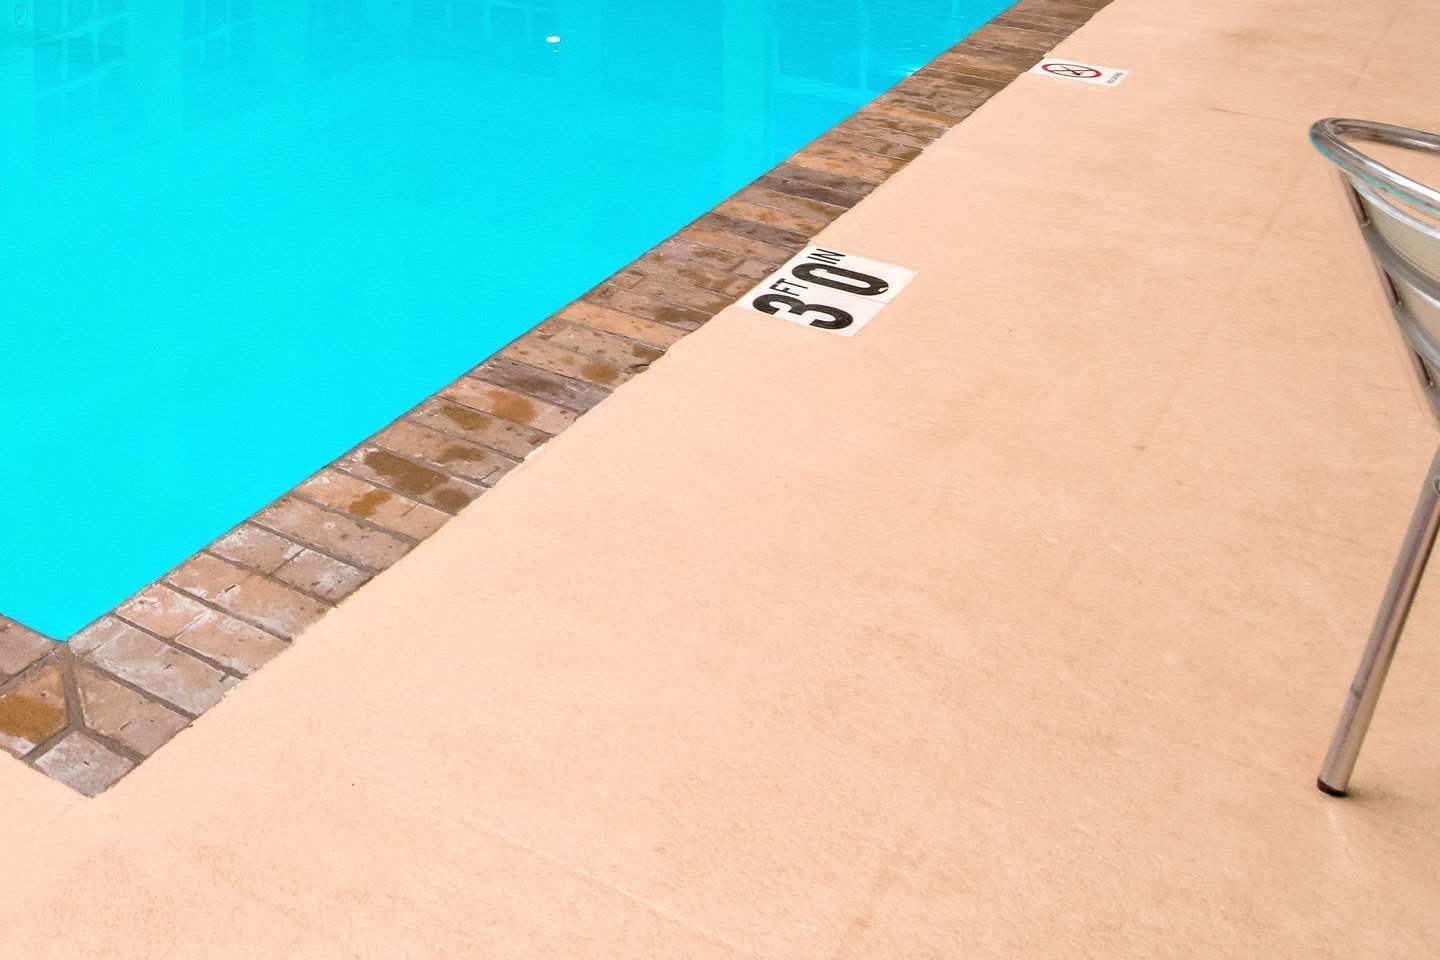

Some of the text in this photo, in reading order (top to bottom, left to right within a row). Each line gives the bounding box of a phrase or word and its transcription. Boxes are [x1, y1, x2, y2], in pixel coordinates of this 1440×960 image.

[752, 248, 890, 330] 3 FT 0 IN
